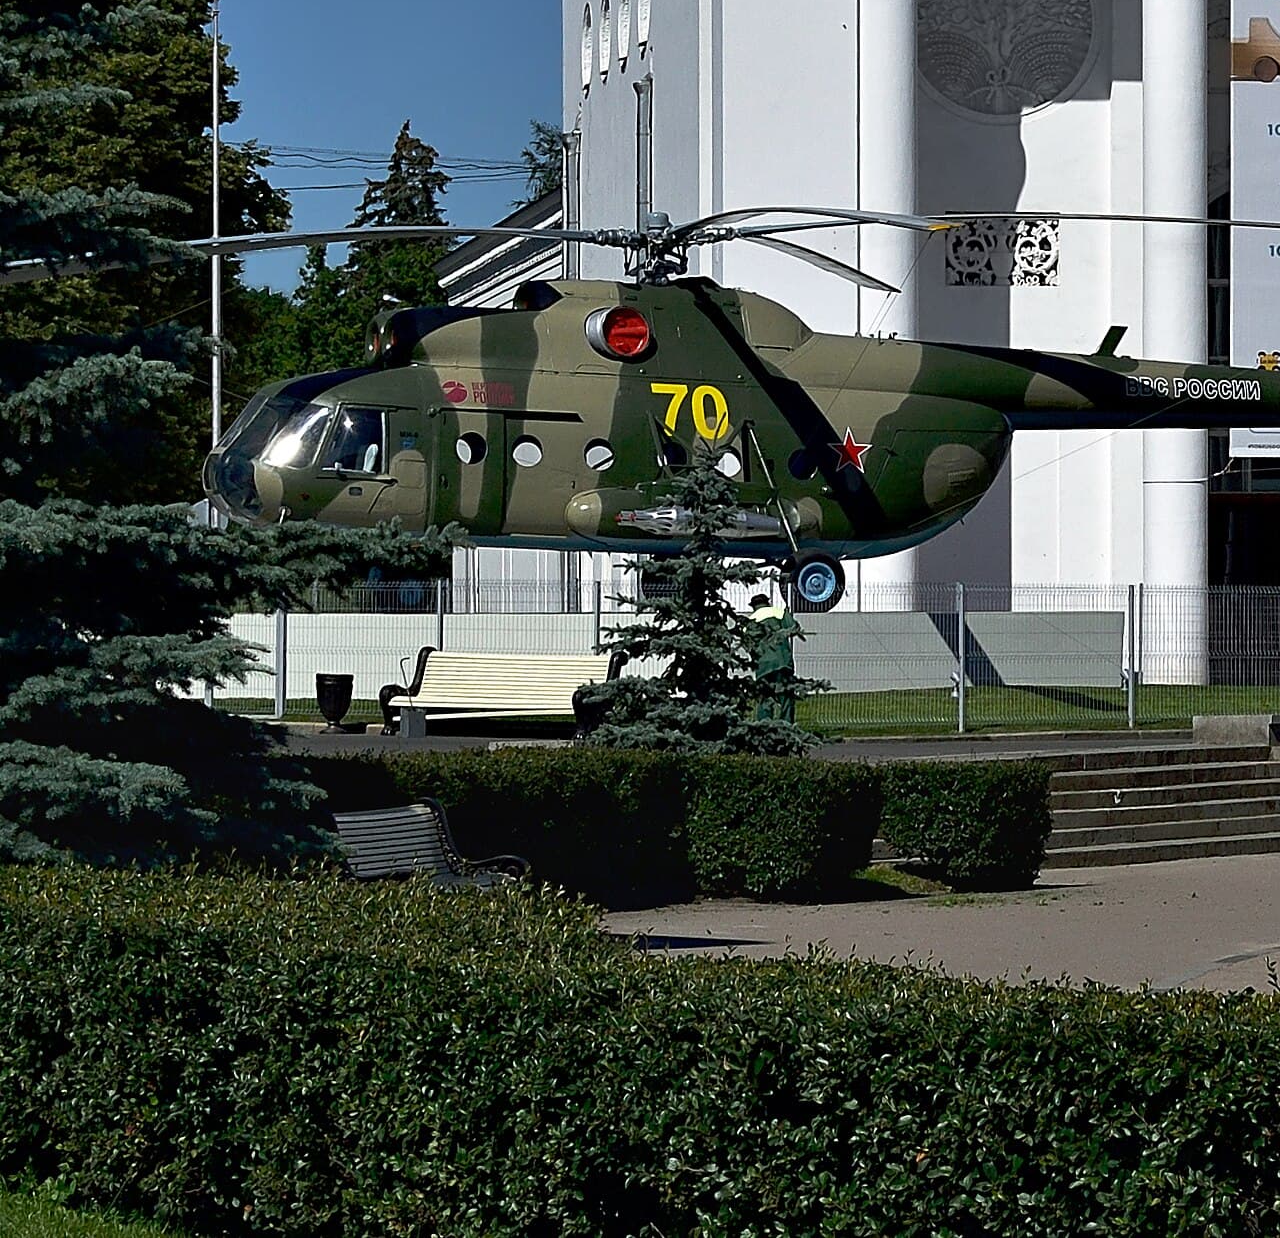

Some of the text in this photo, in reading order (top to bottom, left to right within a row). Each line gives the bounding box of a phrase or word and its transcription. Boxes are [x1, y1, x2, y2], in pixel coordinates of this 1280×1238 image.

[1125, 375, 1262, 401] ВВС РОССИИ
[650, 382, 730, 440] 70
